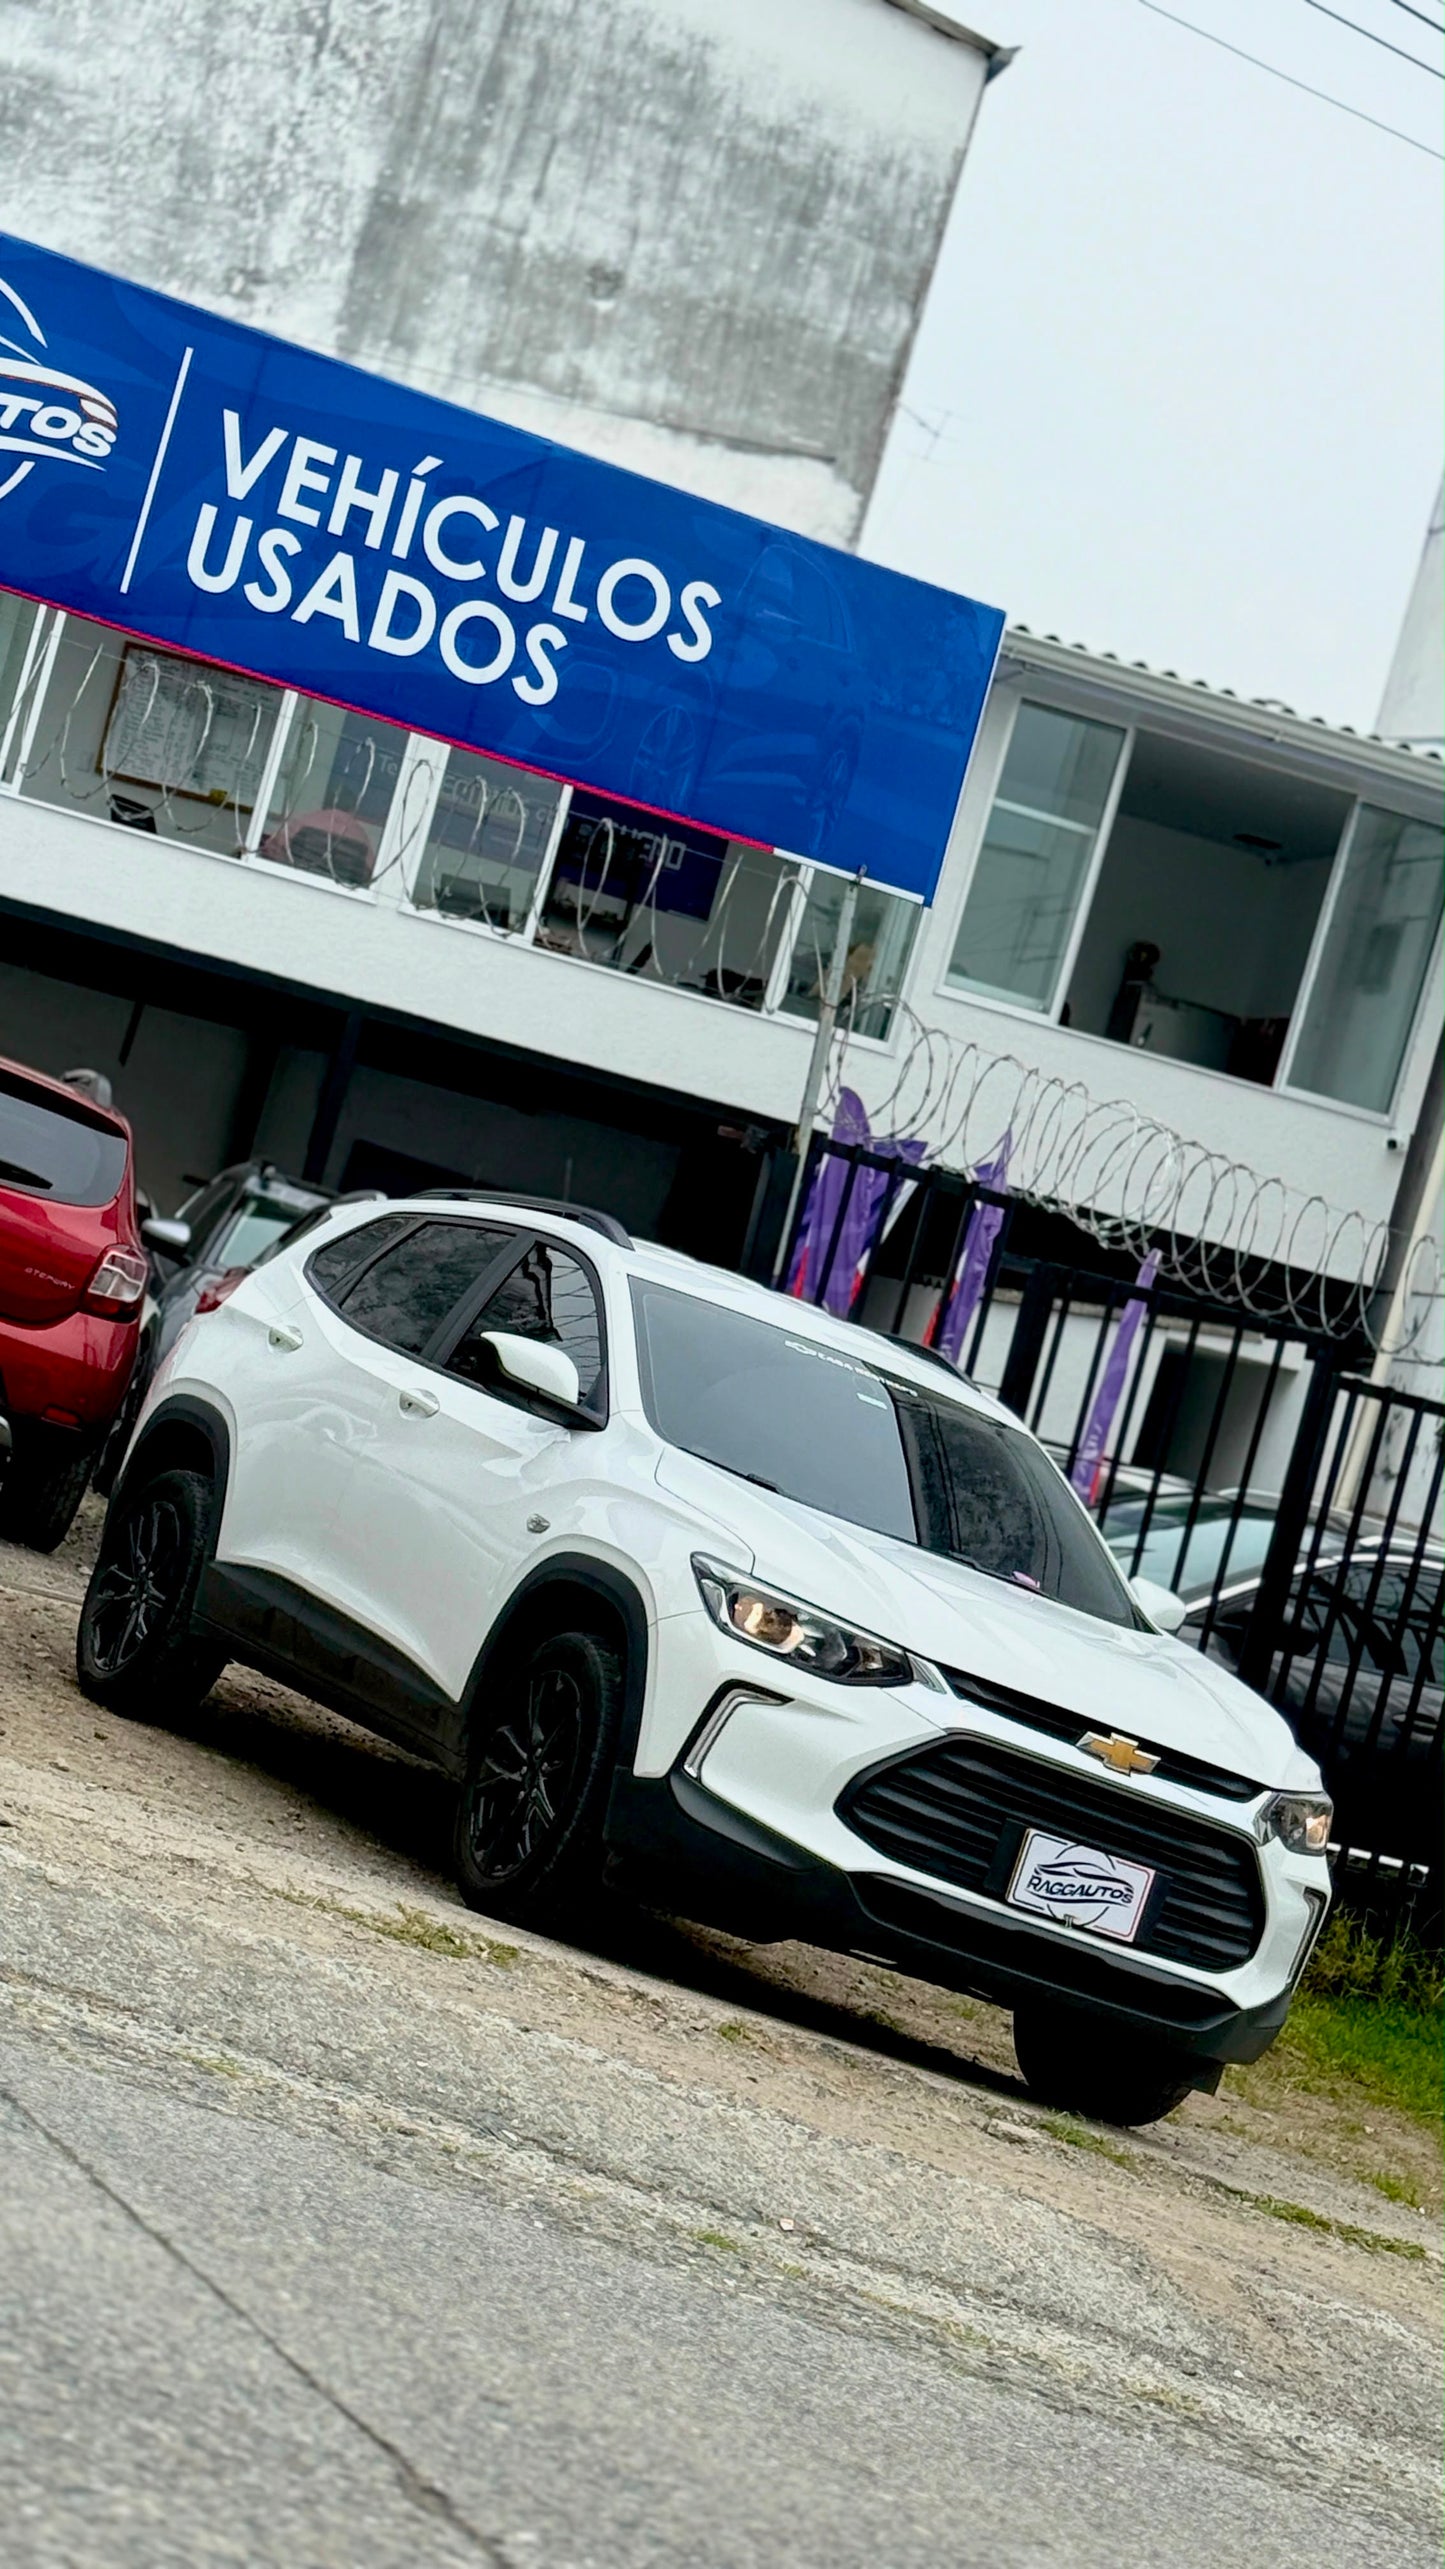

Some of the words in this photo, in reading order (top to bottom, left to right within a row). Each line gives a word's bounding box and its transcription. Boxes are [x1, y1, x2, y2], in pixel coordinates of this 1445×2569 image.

[187, 503, 568, 705] USADOS
[223, 408, 722, 662] VEHÍCULOS
[1027, 1876, 1134, 1904] RAGGAUTOS
